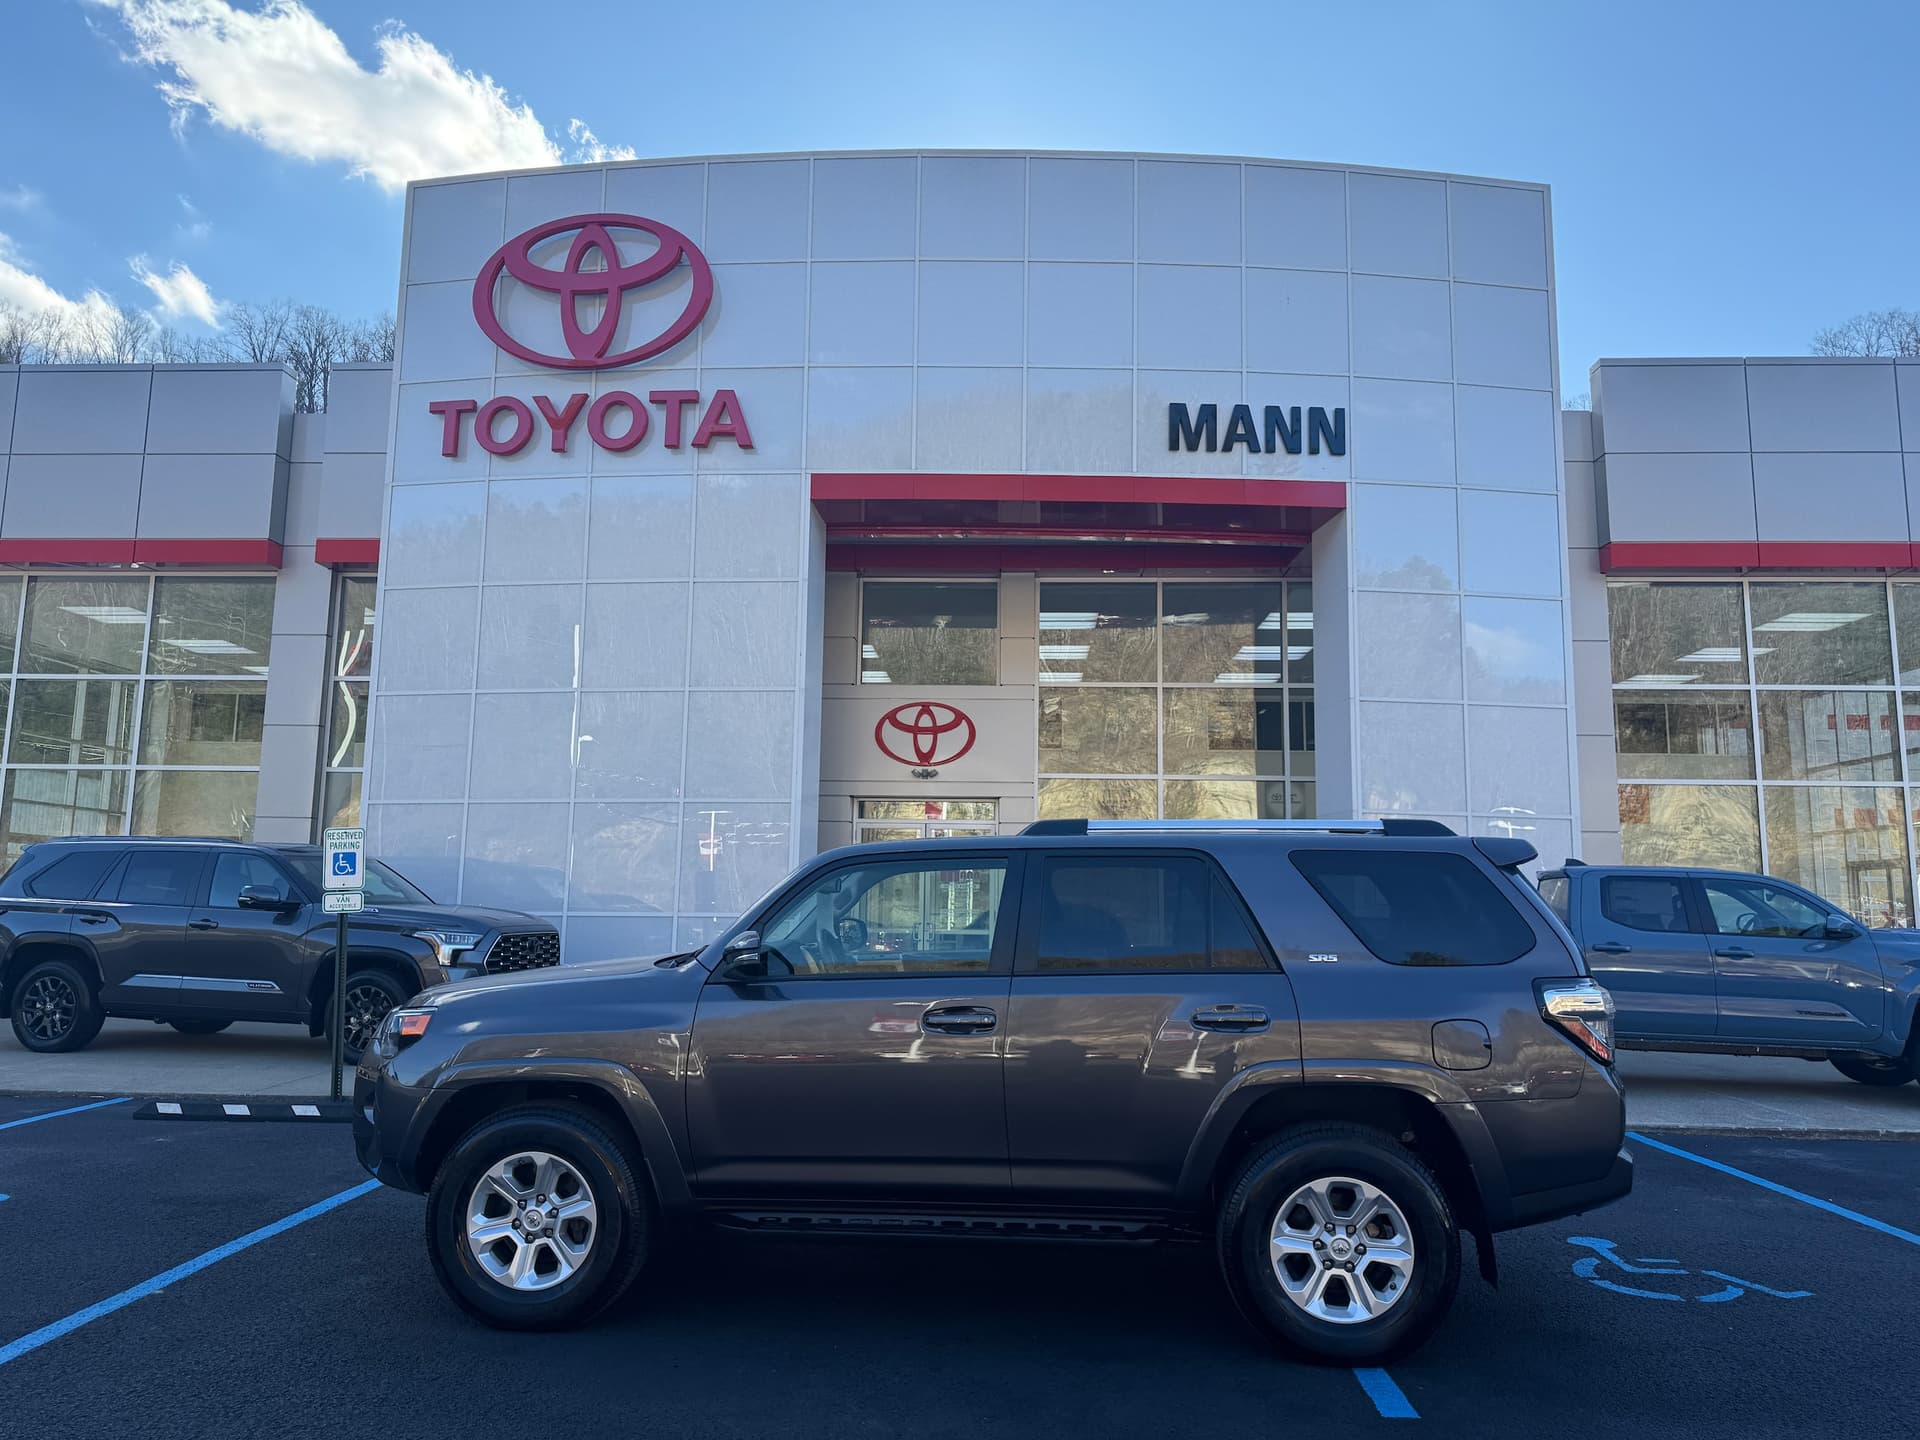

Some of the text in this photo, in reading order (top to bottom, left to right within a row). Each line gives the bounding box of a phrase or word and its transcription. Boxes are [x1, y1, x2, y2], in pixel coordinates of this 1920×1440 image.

[429, 389, 754, 458] TOYOTA
[1168, 402, 1346, 456] MANN
[327, 831, 363, 841] RESERVED
[329, 841, 361, 850] PARKING
[335, 895, 352, 904] VAN
[1307, 953, 1338, 962] SR5
